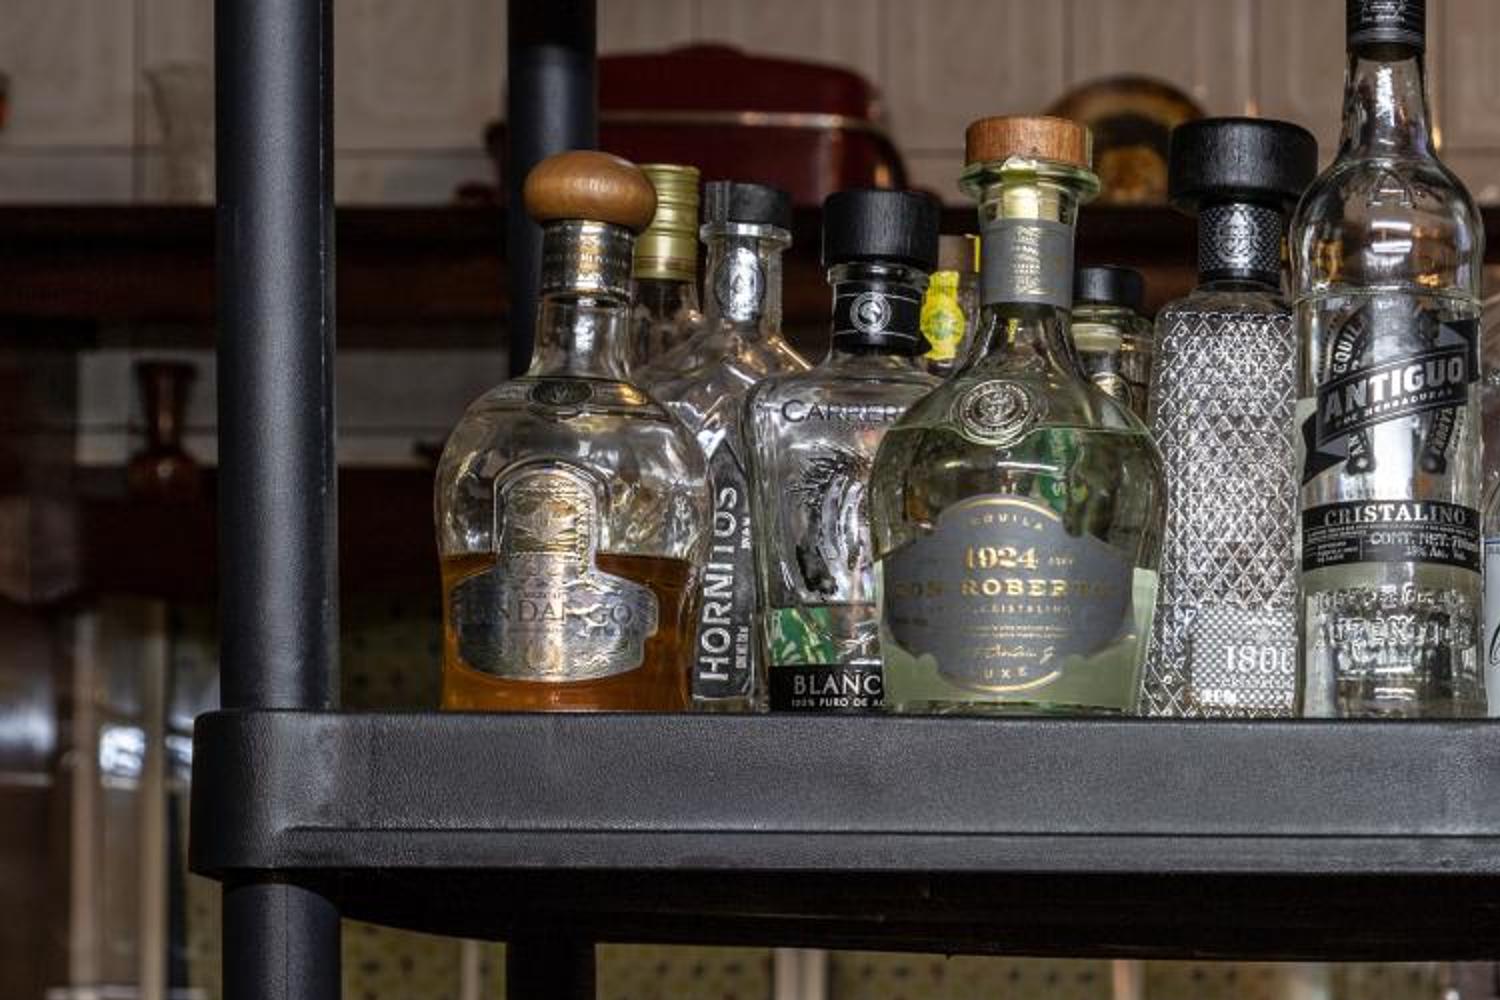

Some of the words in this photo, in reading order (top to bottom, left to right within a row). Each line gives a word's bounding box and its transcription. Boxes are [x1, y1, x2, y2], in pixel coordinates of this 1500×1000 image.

[1325, 357, 1464, 424] ANTIGUO
[782, 400, 898, 423] CARRER
[1325, 503, 1465, 526] CRISTALINO
[700, 487, 738, 681] HORNITOS
[794, 676, 881, 695] BLANC
